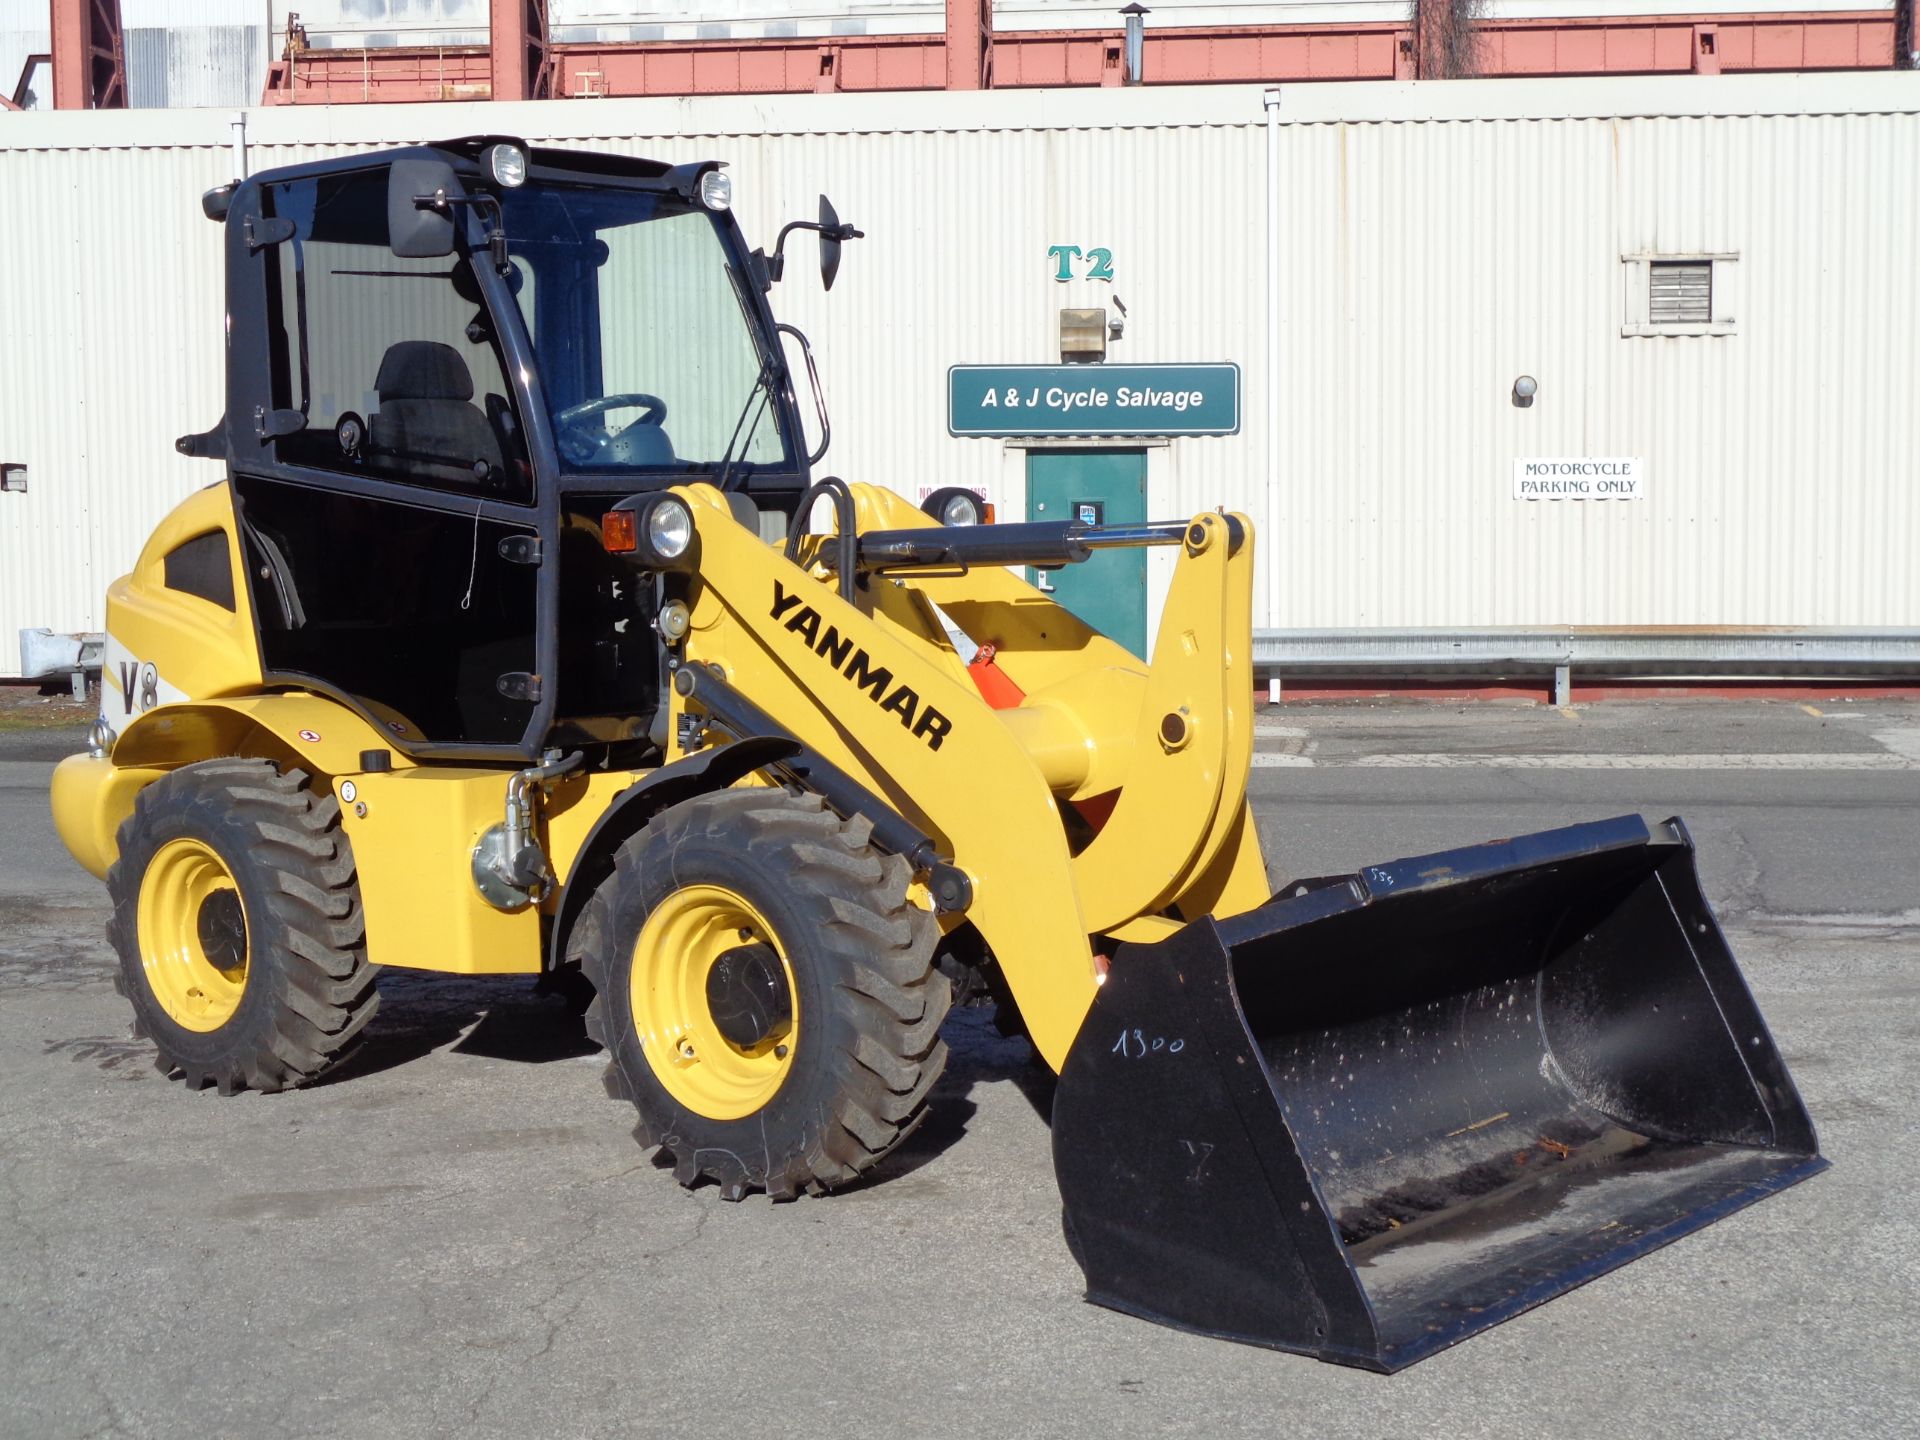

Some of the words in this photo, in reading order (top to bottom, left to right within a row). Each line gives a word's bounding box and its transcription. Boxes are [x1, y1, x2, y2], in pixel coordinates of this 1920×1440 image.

[1047, 244, 1114, 282] T2
[981, 388, 998, 408] A
[1004, 388, 1021, 408] &
[1025, 388, 1039, 408] J
[1046, 387, 1109, 412] Cycle
[1115, 387, 1203, 412] Salvage
[1525, 463, 1631, 475] MOTORCYCLE
[1520, 480, 1590, 493] PARKING
[1596, 480, 1637, 493] ONLY
[769, 579, 953, 752] YANMAR
[119, 661, 158, 715] V8
